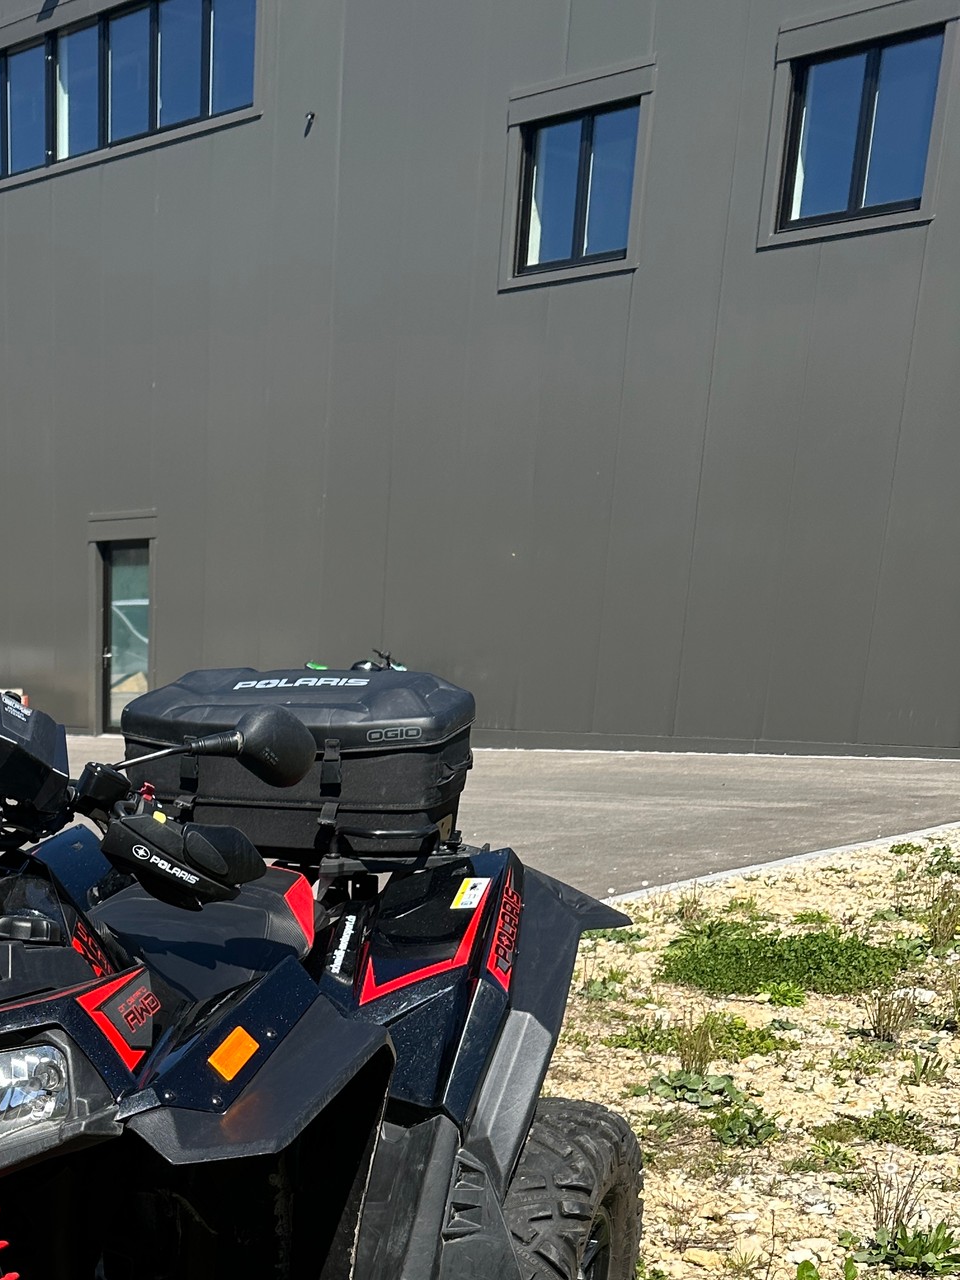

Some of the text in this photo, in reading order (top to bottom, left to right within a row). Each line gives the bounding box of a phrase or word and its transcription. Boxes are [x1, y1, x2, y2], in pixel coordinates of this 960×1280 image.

[233, 677, 371, 690] POLARIS
[367, 727, 422, 742] OGIO
[149, 855, 199, 884] POLARIS
[494, 887, 522, 973] POLARIS
[122, 991, 161, 1033] AWD
